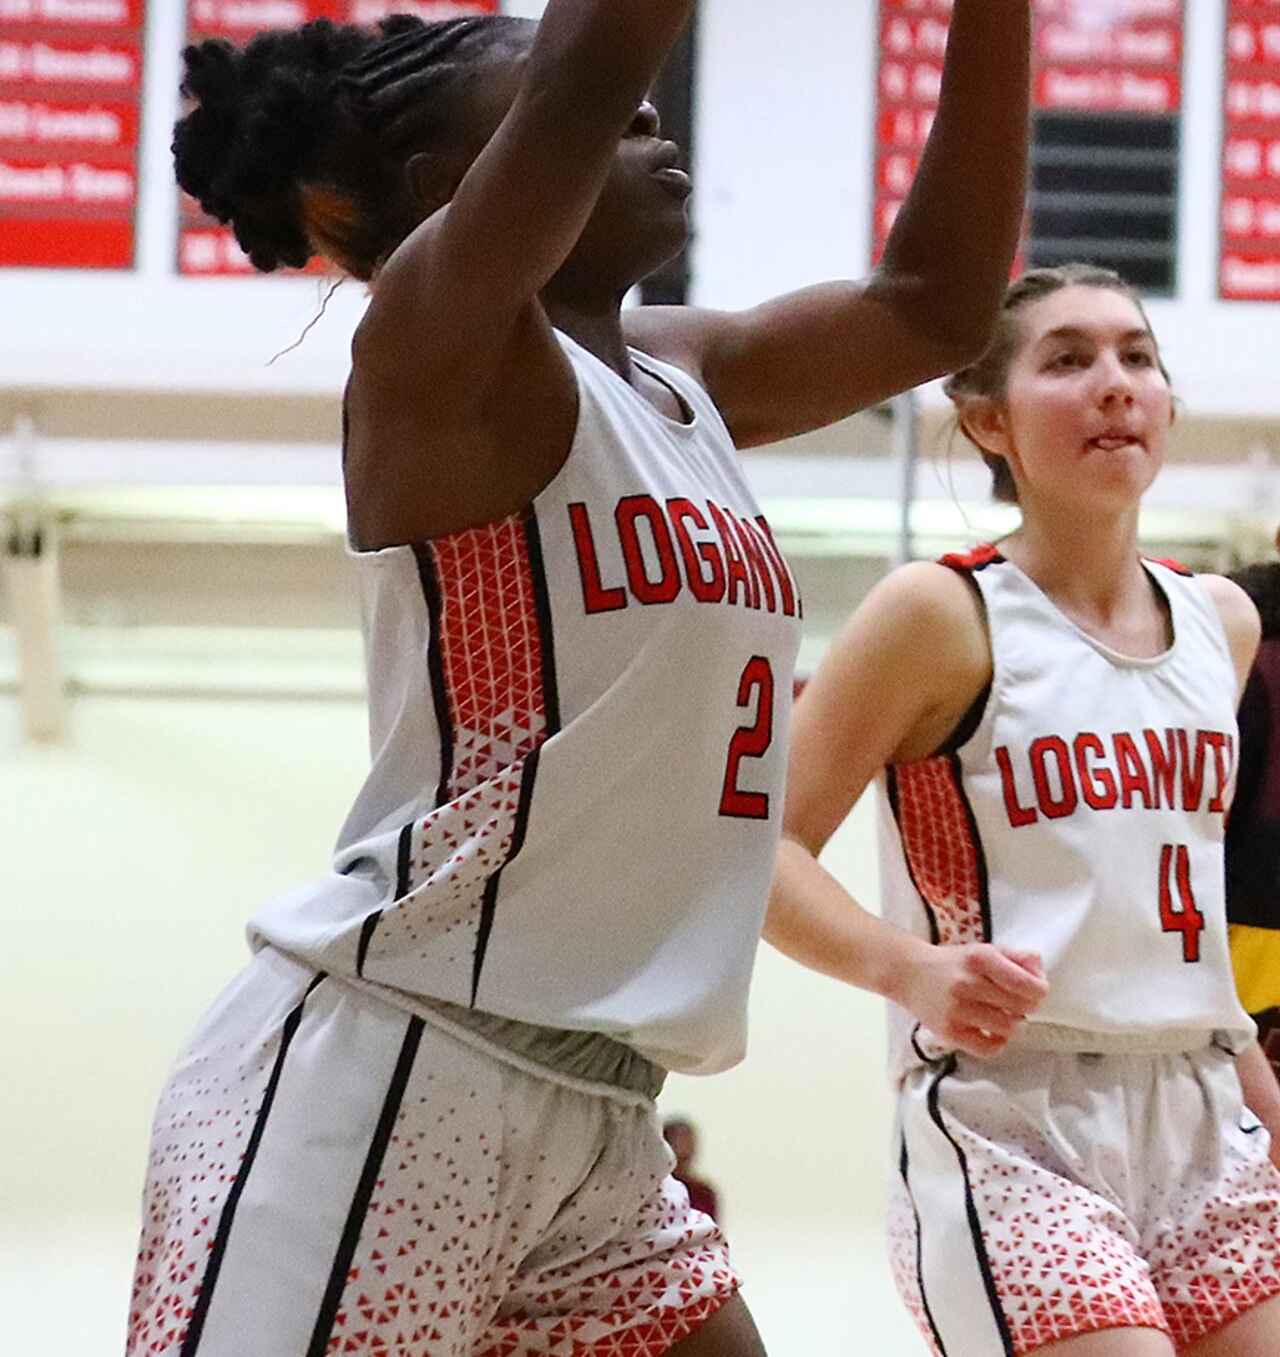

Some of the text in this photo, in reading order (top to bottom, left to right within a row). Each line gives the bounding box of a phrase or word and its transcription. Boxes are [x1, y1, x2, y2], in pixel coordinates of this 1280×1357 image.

[718, 654, 774, 820] 2
[994, 727, 1234, 830] LOGANVI
[1158, 843, 1205, 963] 4
